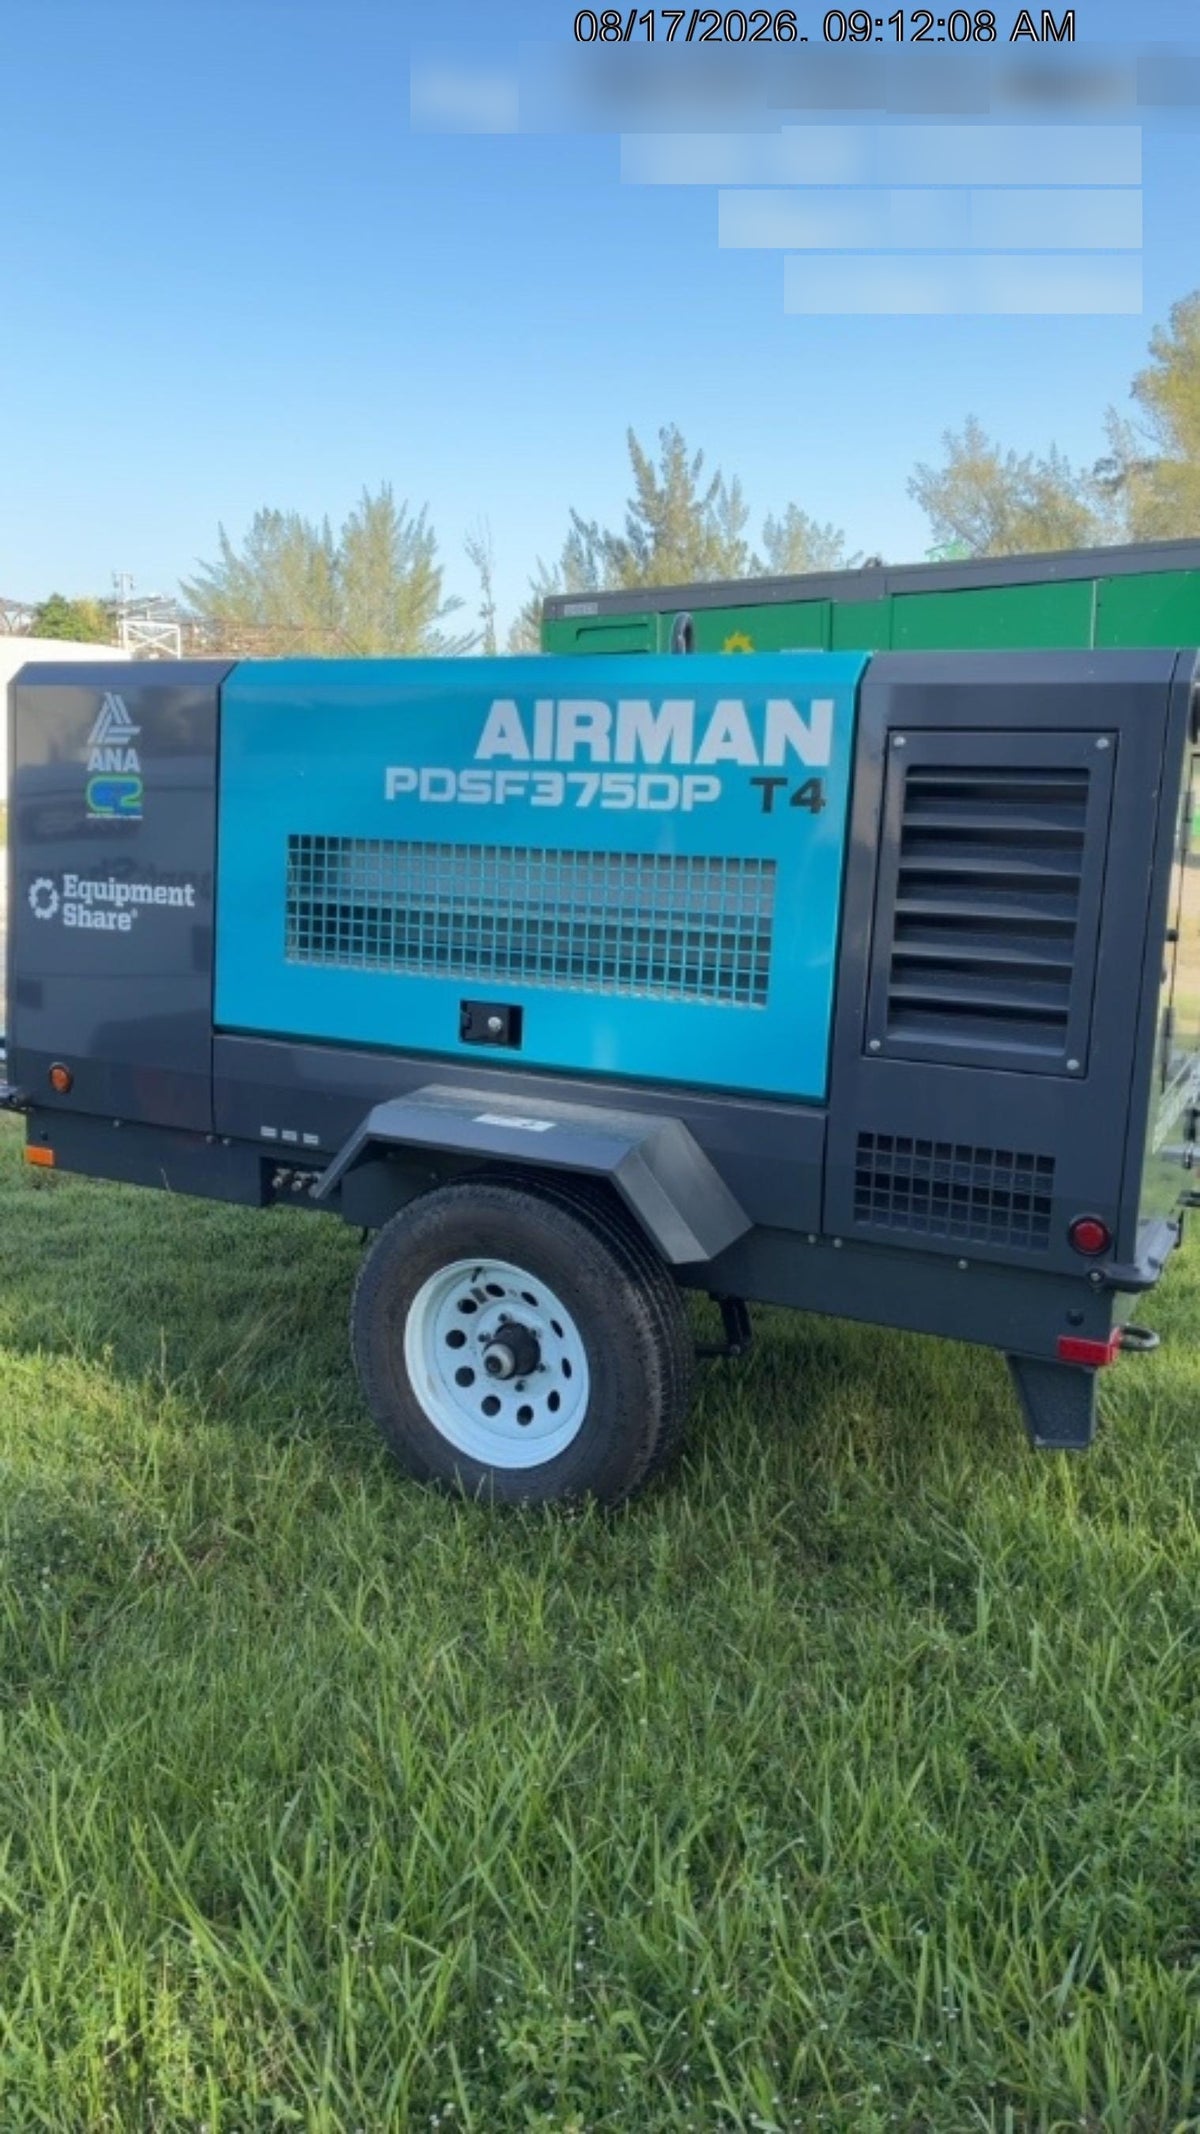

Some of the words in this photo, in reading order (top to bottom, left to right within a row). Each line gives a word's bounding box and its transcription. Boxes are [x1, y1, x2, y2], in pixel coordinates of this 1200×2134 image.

[474, 699, 834, 766] AIRMAN
[87, 748, 141, 771] ANA
[384, 767, 722, 811] PDSF375DP
[750, 777, 827, 814] T4
[62, 874, 196, 908] Equipment
